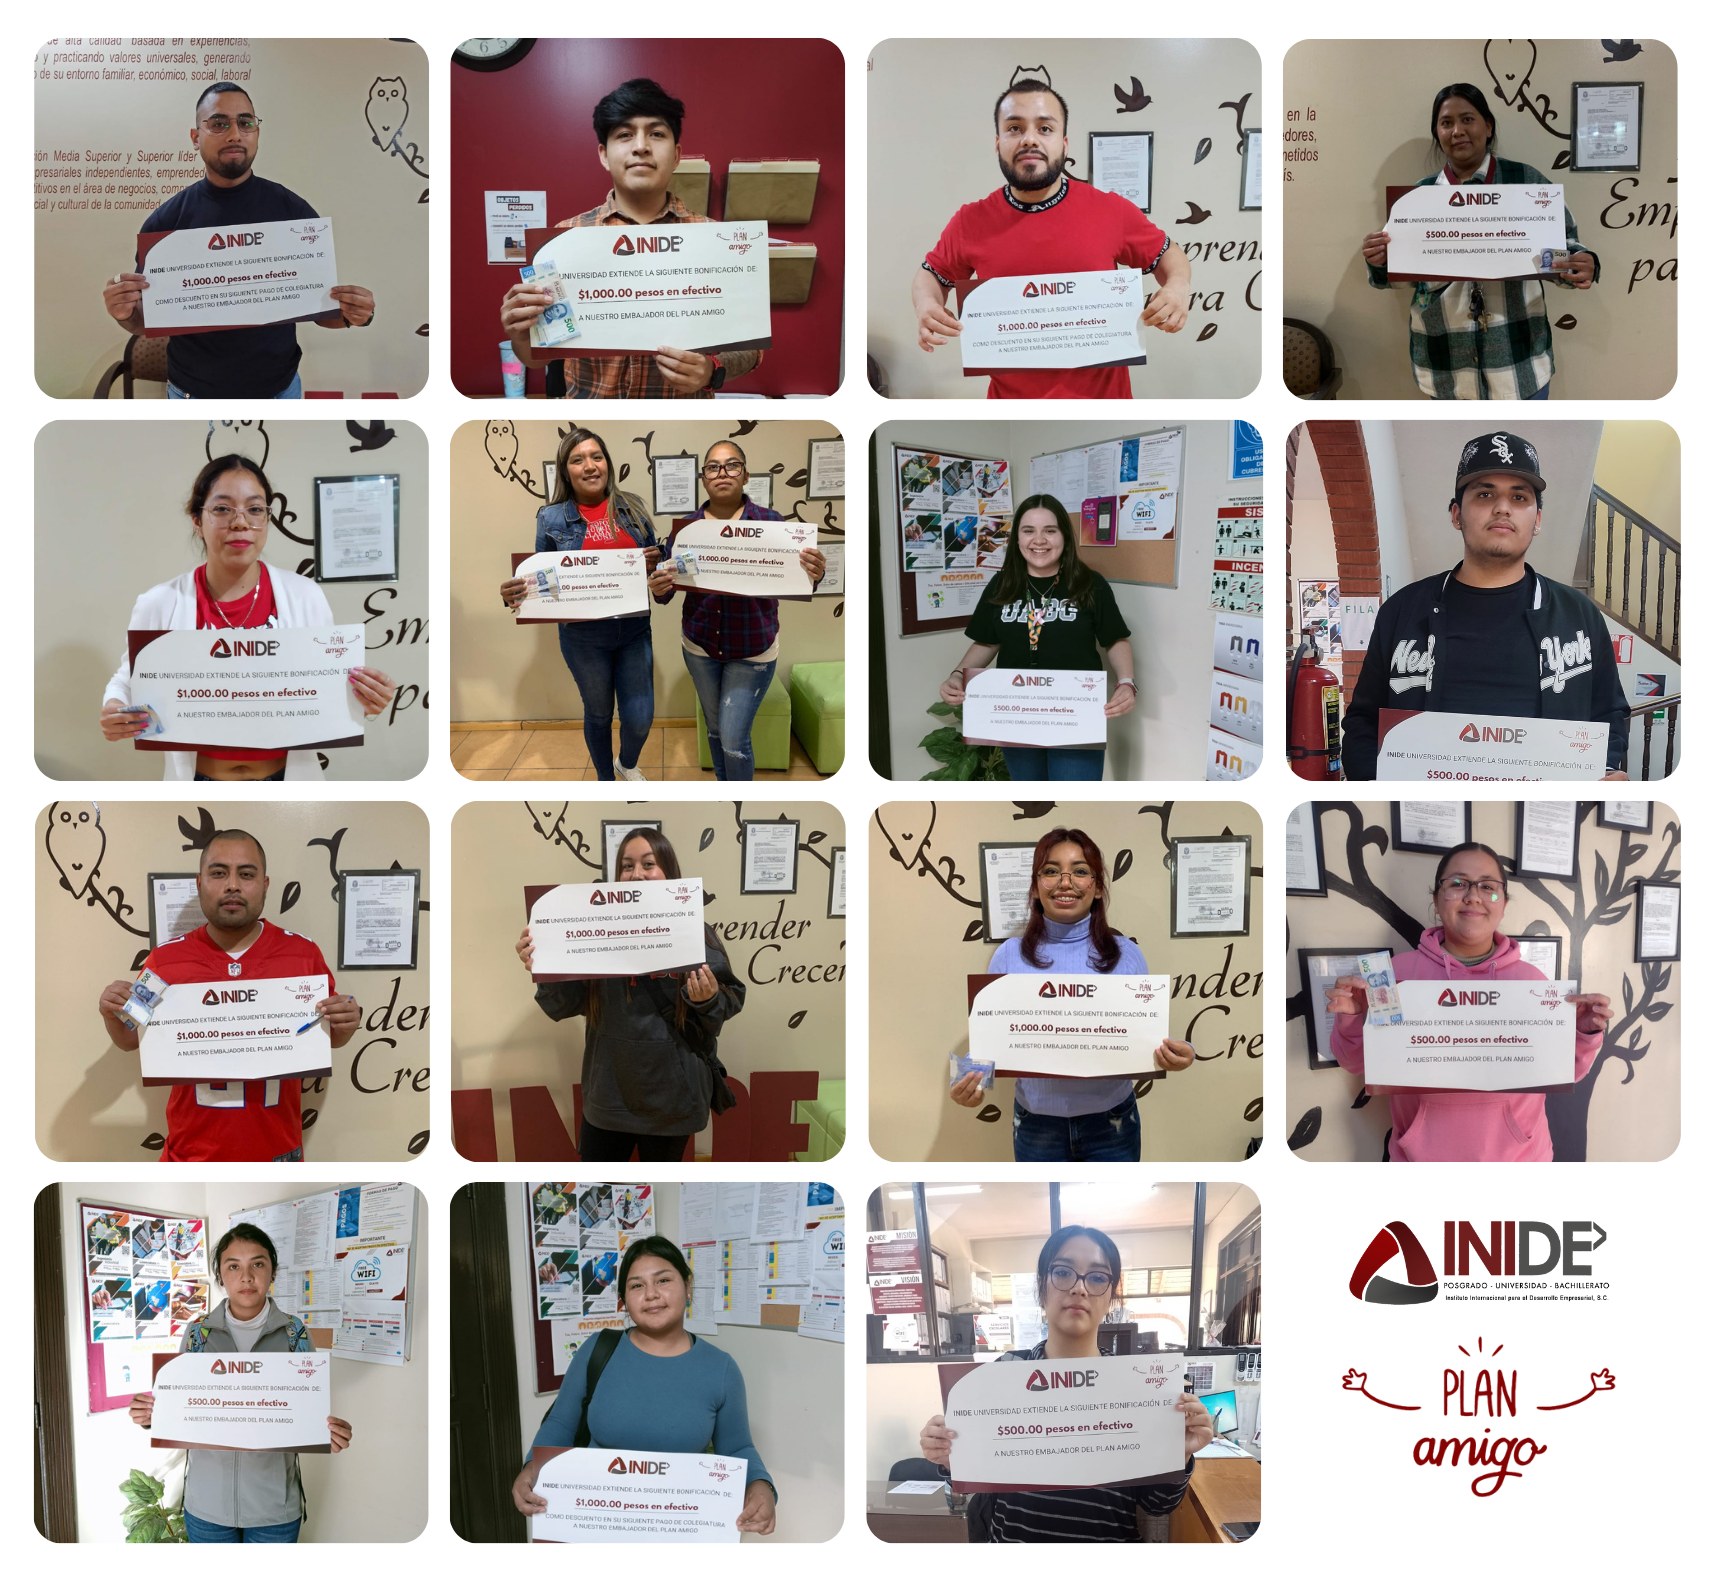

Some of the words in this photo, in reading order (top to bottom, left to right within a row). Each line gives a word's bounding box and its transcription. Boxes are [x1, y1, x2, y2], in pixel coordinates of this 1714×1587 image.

[43, 54, 48, 65] y
[53, 52, 104, 67] practicando
[110, 52, 140, 63] valores
[147, 52, 198, 64] universales,
[204, 52, 250, 66] generando
[40, 68, 50, 79] de
[54, 70, 63, 79] su
[67, 69, 99, 79] entorno
[102, 68, 135, 81] familiar,
[139, 68, 187, 81] económico,
[191, 68, 217, 81] social,
[221, 68, 251, 80] laboral
[1287, 110, 1300, 121] en
[1307, 107, 1316, 120] la
[54, 150, 79, 161] Media
[86, 150, 122, 163] Superior
[126, 153, 132, 164] y
[137, 150, 173, 163] Superior
[178, 150, 197, 161] líder
[86, 167, 152, 179] independientes,
[1467, 193, 1501, 205] INIDE
[227, 232, 264, 247] INIDE
[734, 232, 747, 241] PLAN
[1426, 230, 1459, 239] $500.00
[637, 236, 683, 253] INIDE
[729, 243, 752, 255] amigo
[182, 275, 225, 288] $1,000.00
[228, 275, 250, 284] pesos
[265, 269, 297, 279] efectivo
[578, 287, 632, 299] $1,000.00
[635, 289, 664, 298] pesos
[682, 285, 721, 295] efectivo
[1041, 282, 1076, 295] INIDE
[564, 318, 575, 333] 500
[998, 321, 1038, 332] $1,000.00
[1041, 322, 1062, 330] pesos
[1076, 317, 1106, 326] efectivo
[735, 527, 764, 538] INIDE
[574, 557, 599, 565] INIDE
[234, 641, 280, 656] INIDE
[1541, 630, 1592, 693] York
[1027, 676, 1054, 686] INIDE
[177, 688, 230, 699] $1,000.00
[233, 690, 260, 698] pesos
[278, 687, 317, 696] efectivo
[1482, 727, 1527, 743] INIDE
[1427, 770, 1469, 781] $500.00
[608, 891, 642, 903] INIDE
[566, 928, 605, 939] $1,000.00
[642, 925, 670, 933] efectivo
[1362, 959, 1370, 973] 500
[141, 973, 151, 985] 500
[221, 989, 258, 1003] INIDE
[1059, 984, 1097, 997] INIDE
[1459, 991, 1500, 1005] INIDE
[177, 1030, 219, 1040] $1,000.00
[221, 1031, 243, 1039] pesos
[258, 1026, 290, 1035] efectivo
[1010, 1024, 1053, 1033] $1,000.00
[1411, 1035, 1450, 1045] $500.00
[228, 1361, 263, 1373] INIDE
[1150, 1365, 1163, 1374] PLAN
[1051, 1370, 1098, 1388] INIDE
[1146, 1376, 1168, 1388] amigo
[188, 1398, 220, 1407] $500.00
[1110, 1399, 1160, 1408] BONIFICACIÓN
[998, 1424, 1042, 1436] $500.00
[1046, 1426, 1074, 1435] pesos
[1093, 1421, 1133, 1431] efectivo
[629, 1460, 670, 1475] INIDE
[576, 1500, 621, 1510] $1,000.00
[664, 1502, 698, 1511] efectivo
